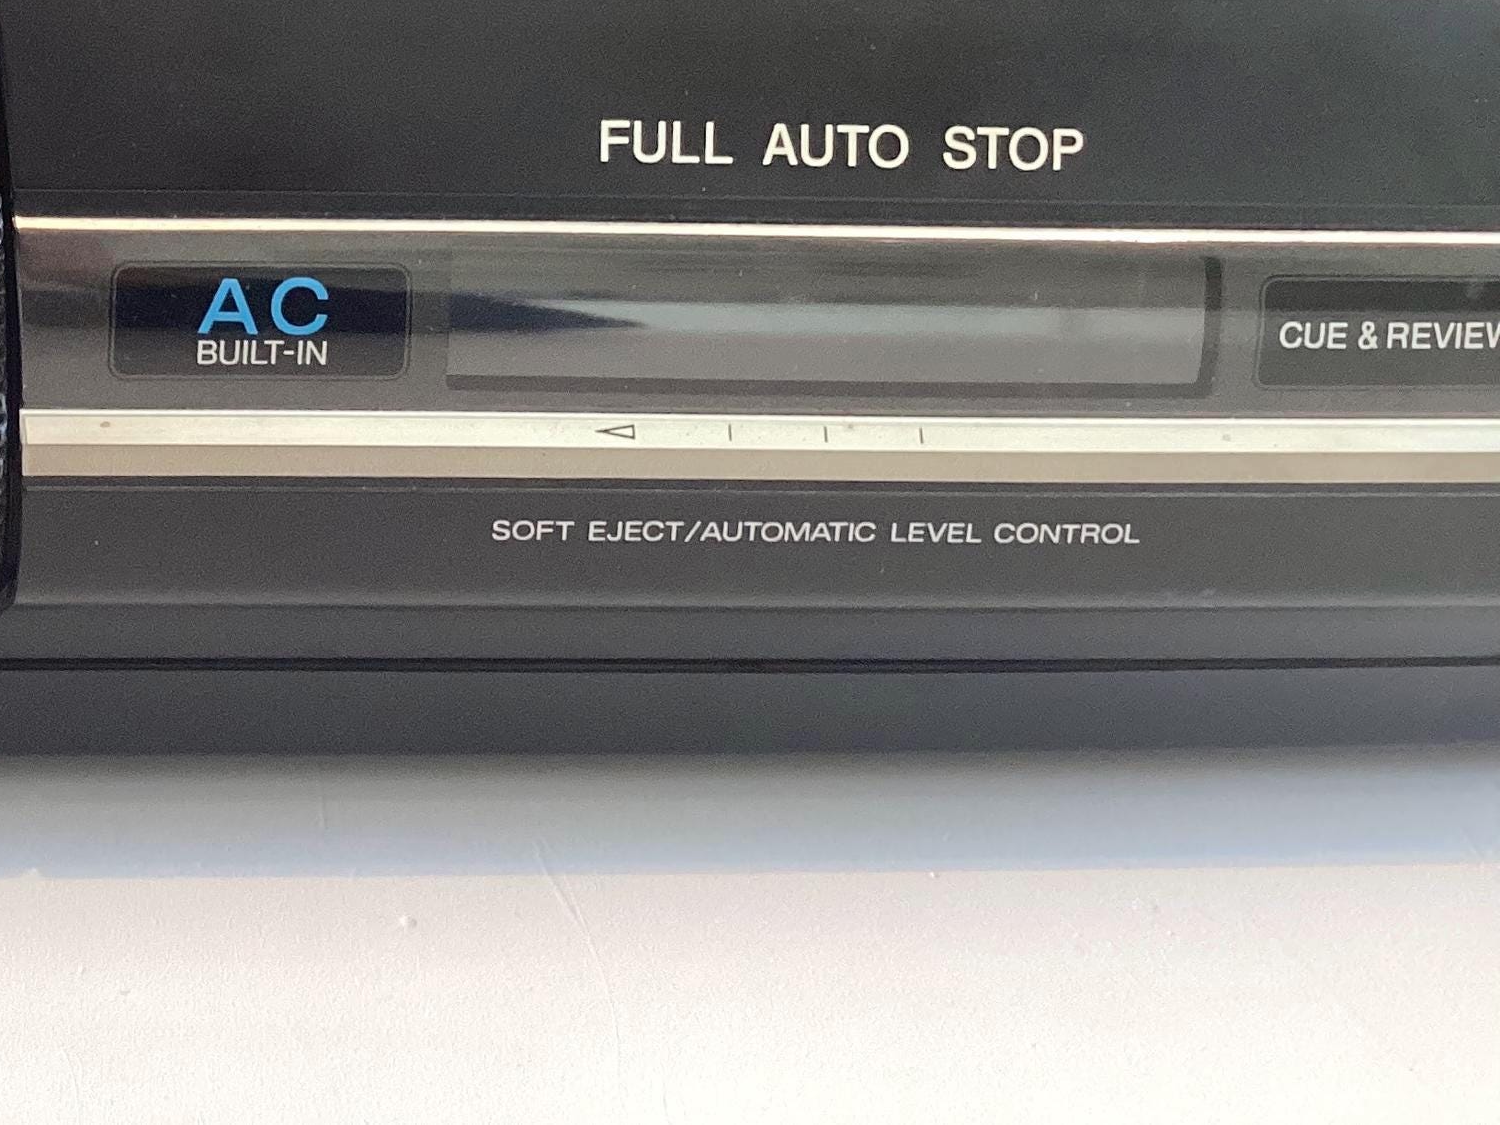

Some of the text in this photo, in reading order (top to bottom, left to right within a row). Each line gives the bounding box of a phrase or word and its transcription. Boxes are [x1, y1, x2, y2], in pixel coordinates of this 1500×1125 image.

[600, 118, 1086, 172] FULL AUTO STOP
[1279, 320, 1348, 350] CUE
[1357, 320, 1379, 350] &
[196, 339, 329, 366] BUILT-IN
[491, 519, 1141, 546] SOFT EJECT/AUTOMATIC LEVEL CONTROL
